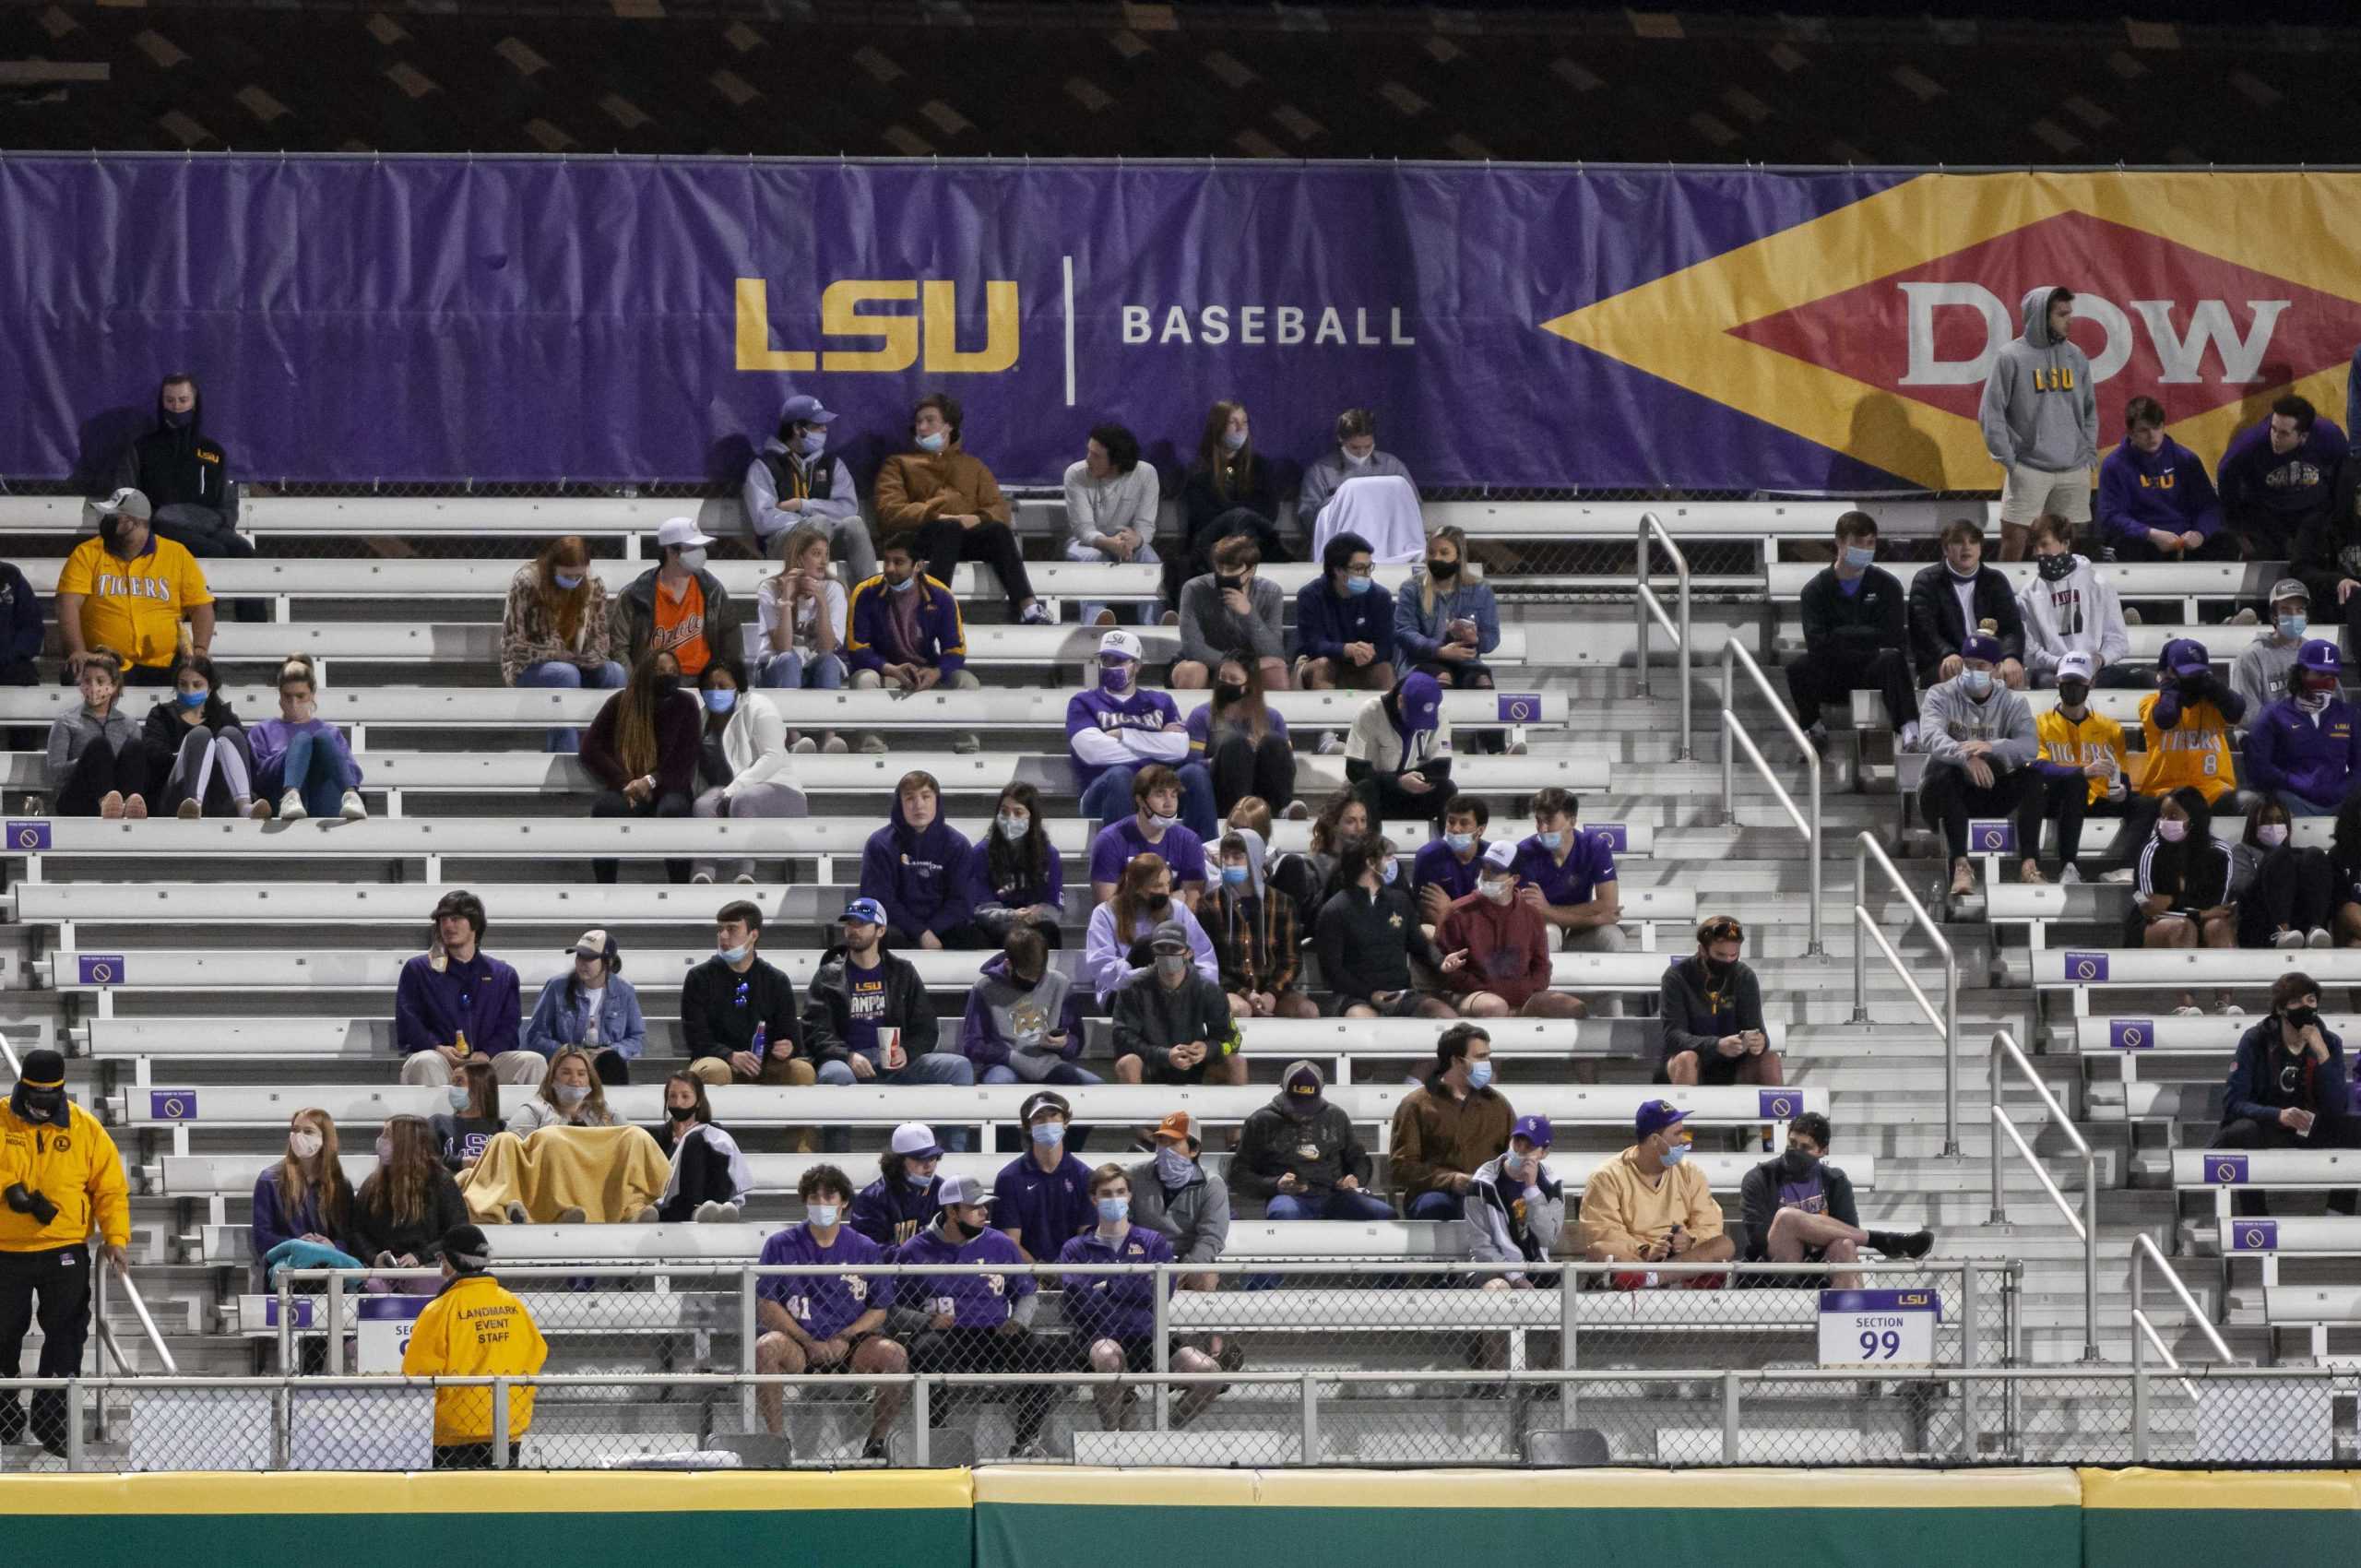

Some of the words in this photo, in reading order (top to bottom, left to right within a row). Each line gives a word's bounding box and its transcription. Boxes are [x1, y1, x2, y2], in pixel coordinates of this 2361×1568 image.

[736, 278, 1019, 373] LSU
[1122, 304, 1416, 347] BASEBALL
[2033, 368, 2074, 391] LSU
[2140, 473, 2174, 489] LU
[99, 573, 171, 601] TIGERS
[2324, 647, 2334, 663] L
[2047, 741, 2116, 766] TIGERS
[2203, 754, 2217, 776] 8
[855, 981, 883, 992] LSU
[1293, 1084, 1315, 1095] LSU
[1897, 1293, 1928, 1305] LSU
[457, 1304, 519, 1322] LANDMARK
[474, 1319, 509, 1332] EVENT
[1855, 1317, 1904, 1328] SECTION
[477, 1333, 510, 1345] STAFF
[1859, 1330, 1902, 1360] 99
